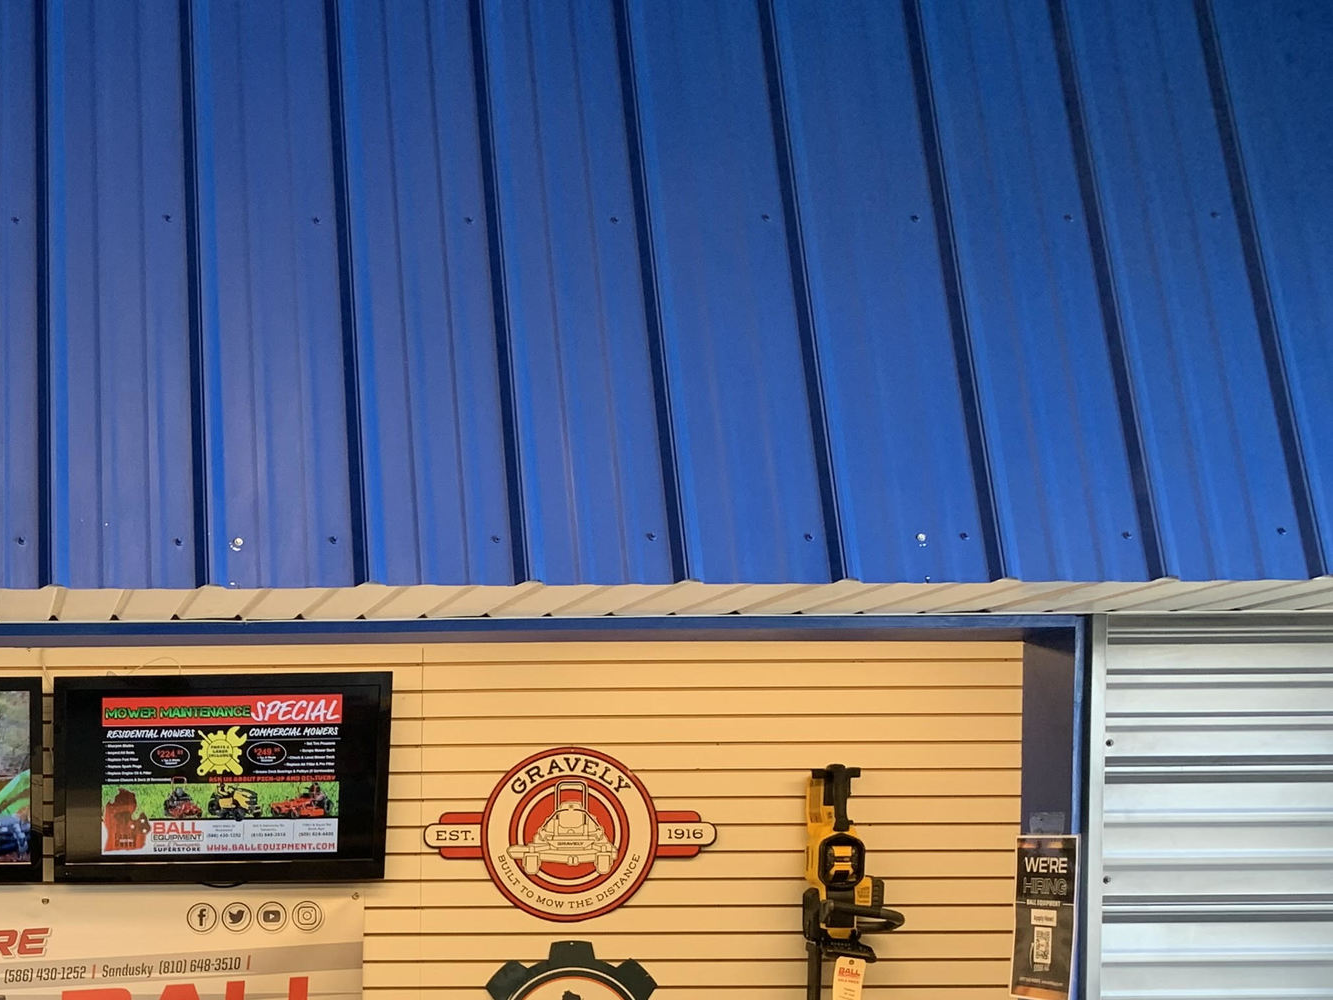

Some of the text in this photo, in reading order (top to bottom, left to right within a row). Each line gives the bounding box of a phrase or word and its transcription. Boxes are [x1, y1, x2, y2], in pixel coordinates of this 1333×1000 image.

[106, 699, 340, 722] MOWER MAINTENANCE SPECIAL
[107, 729, 195, 739] RESIDENTIAL MOWERS
[249, 727, 338, 736] COMMERCIAL MOWERS
[510, 757, 631, 794] GRAVELY
[154, 822, 202, 834] BALL
[667, 829, 703, 839] 1916
[435, 830, 475, 841] EST.
[207, 843, 335, 851] WWW.BALLEQUIPMENT.COM
[1025, 857, 1067, 873] WE'RE
[498, 853, 641, 908] BUILT TO MOW THE DISTANCE
[4, 969, 34, 983] (586)
[36, 965, 86, 981] 430-1252
[102, 963, 153, 978] Sandusky
[158, 961, 186, 975] (810)
[190, 957, 241, 972] 648-3510
